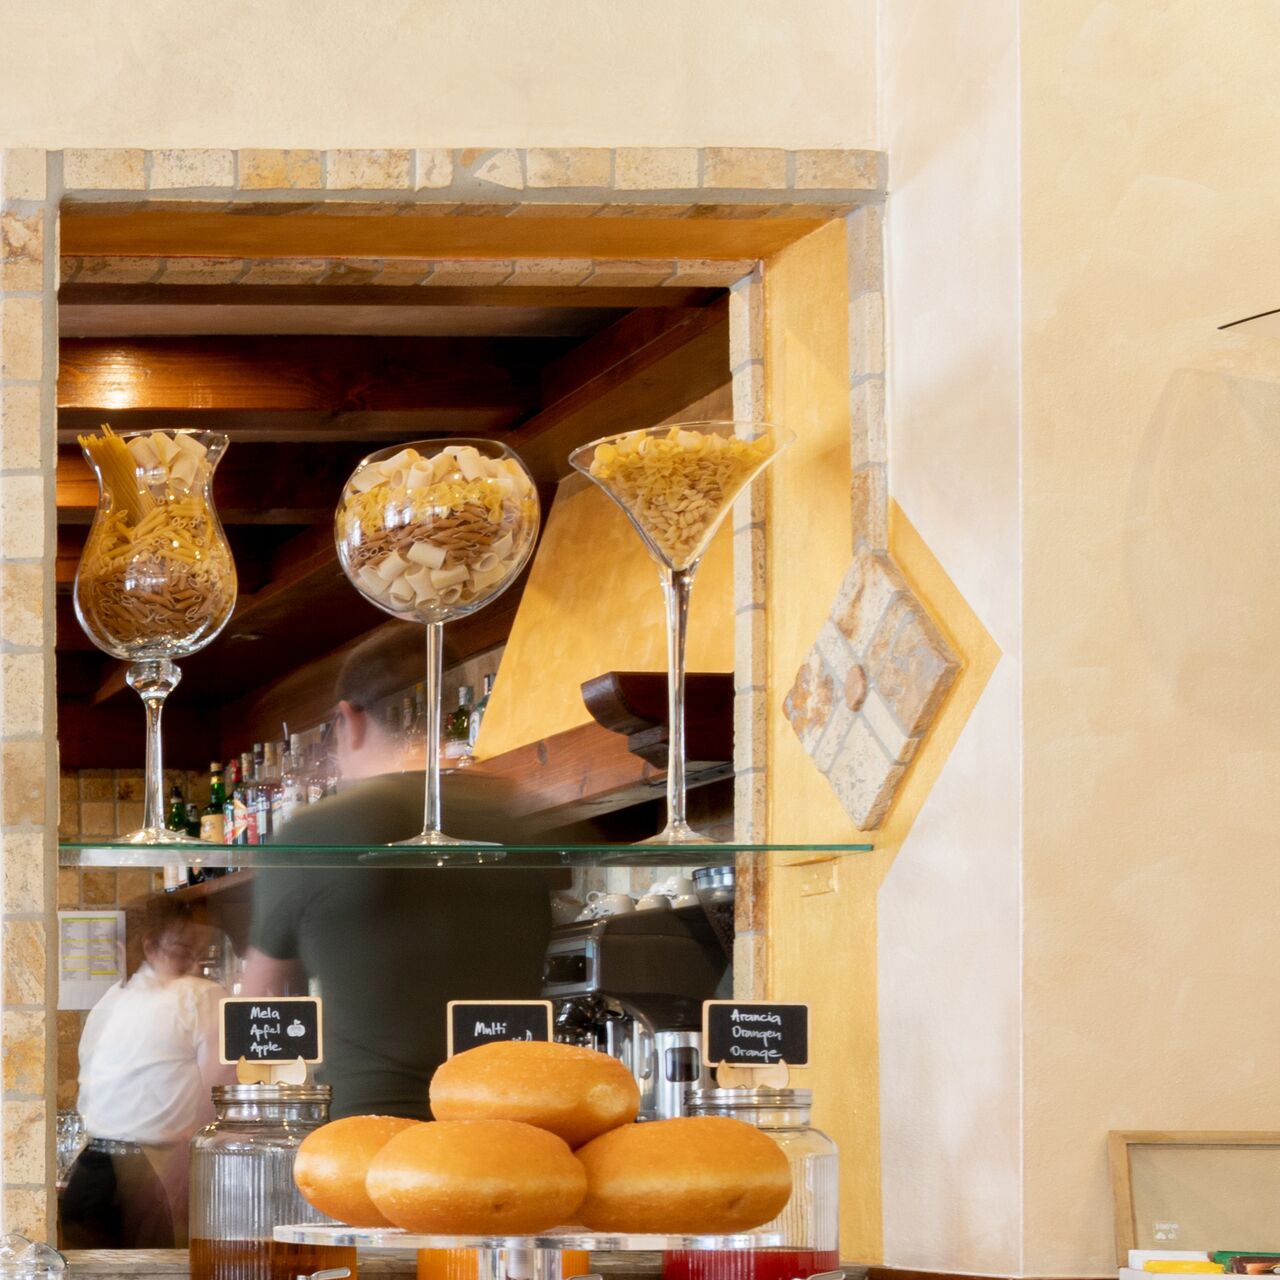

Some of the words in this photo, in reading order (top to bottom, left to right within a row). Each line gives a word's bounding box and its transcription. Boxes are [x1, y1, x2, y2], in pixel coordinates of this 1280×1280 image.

[250, 1006, 281, 1020] Mela
[730, 1008, 782, 1026] Arancia
[250, 1023, 281, 1042] Apfel
[731, 1025, 782, 1048] Orangen
[250, 1041, 282, 1058] Apple
[729, 1045, 782, 1063] Orange
